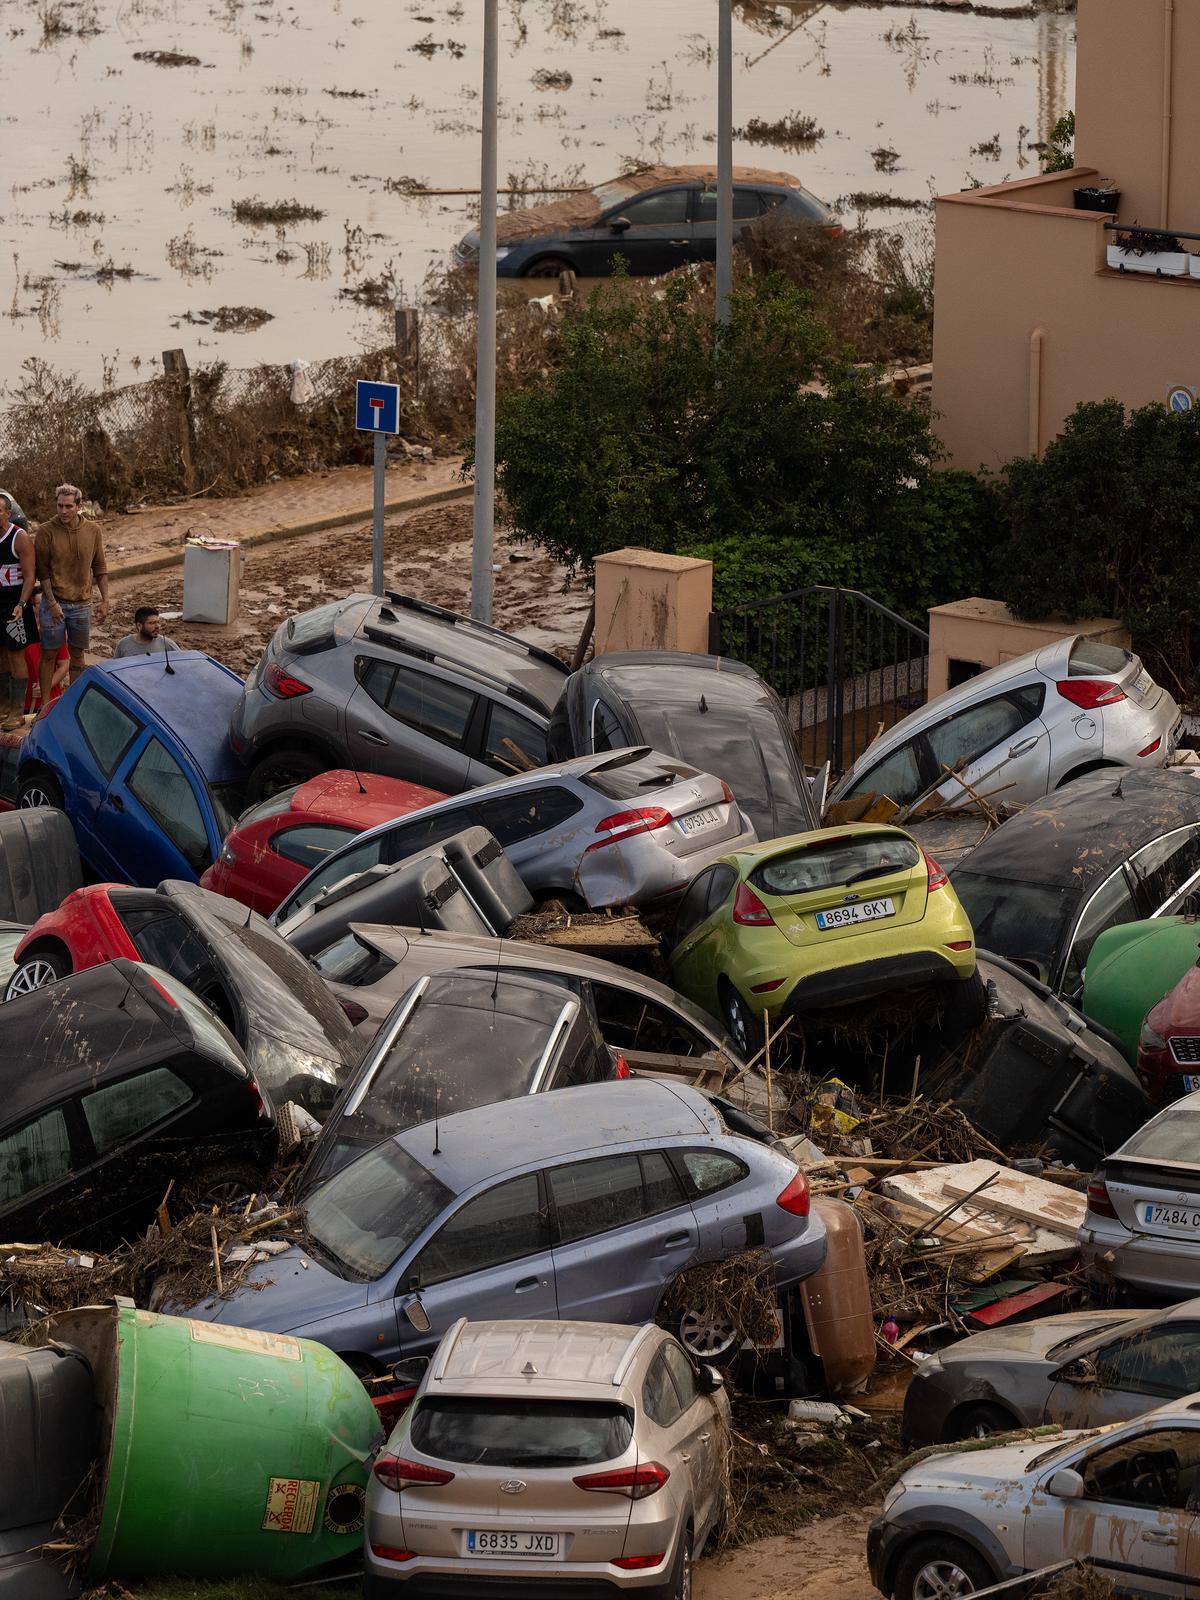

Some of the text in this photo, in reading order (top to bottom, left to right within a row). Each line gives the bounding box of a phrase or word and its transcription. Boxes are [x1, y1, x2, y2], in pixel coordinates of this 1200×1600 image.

[17, 617, 28, 645] adida
[685, 808, 718, 830] 6753 LJL
[825, 907, 859, 924] 8694
[863, 900, 889, 916] GKY
[1154, 1207, 1188, 1225] 7484
[279, 1480, 299, 1530] RECUERDA
[479, 1533, 554, 1551] 6835 JXD
